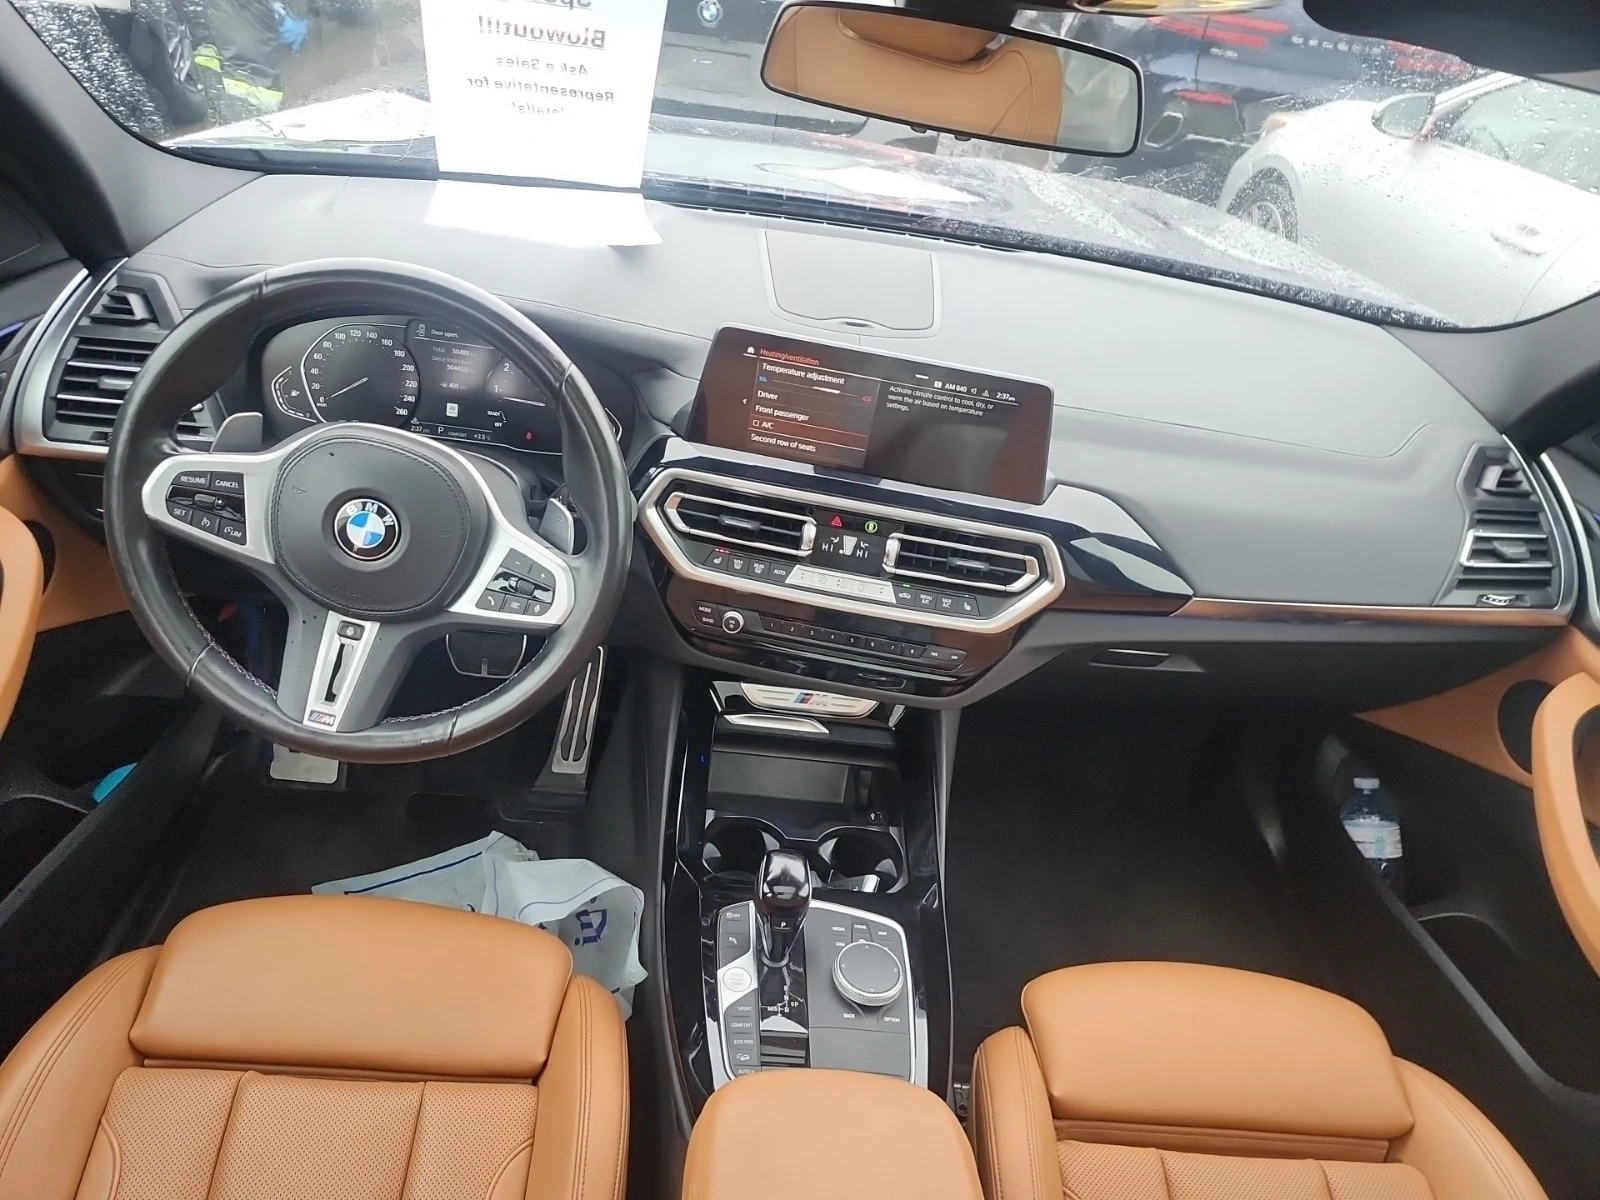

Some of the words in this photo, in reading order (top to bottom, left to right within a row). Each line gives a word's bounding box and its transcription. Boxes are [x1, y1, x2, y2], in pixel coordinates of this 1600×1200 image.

[350, 329, 361, 337] 120
[366, 331, 377, 339] 140
[760, 348, 820, 366] Heating/ventilation
[402, 364, 414, 372] 200
[503, 363, 510, 372] 2
[762, 362, 805, 377] Temperature
[806, 371, 845, 385] adjustment
[405, 380, 417, 388] 220
[944, 383, 955, 391] AM
[956, 384, 967, 392] 640
[493, 385, 498, 393] 1
[403, 395, 415, 403] 240
[757, 390, 779, 400] Driver
[889, 385, 912, 395] Activate
[912, 388, 933, 398] climate
[933, 392, 954, 402] control
[961, 398, 975, 407] cool,
[886, 402, 910, 412] settings.
[904, 395, 914, 403] the
[922, 399, 940, 408] based
[949, 404, 983, 417] temperature
[395, 408, 407, 416] 260
[755, 405, 773, 414] Front
[774, 409, 810, 421] passenger
[751, 433, 776, 444] Second
[777, 439, 789, 447] row
[798, 443, 817, 452] seats
[180, 475, 208, 485] RESUME
[215, 480, 239, 488] CANCEL
[173, 508, 187, 516] SET
[345, 501, 395, 526] BMW
[230, 529, 243, 538] LIM
[822, 543, 834, 552] HI
[856, 549, 868, 558] HI
